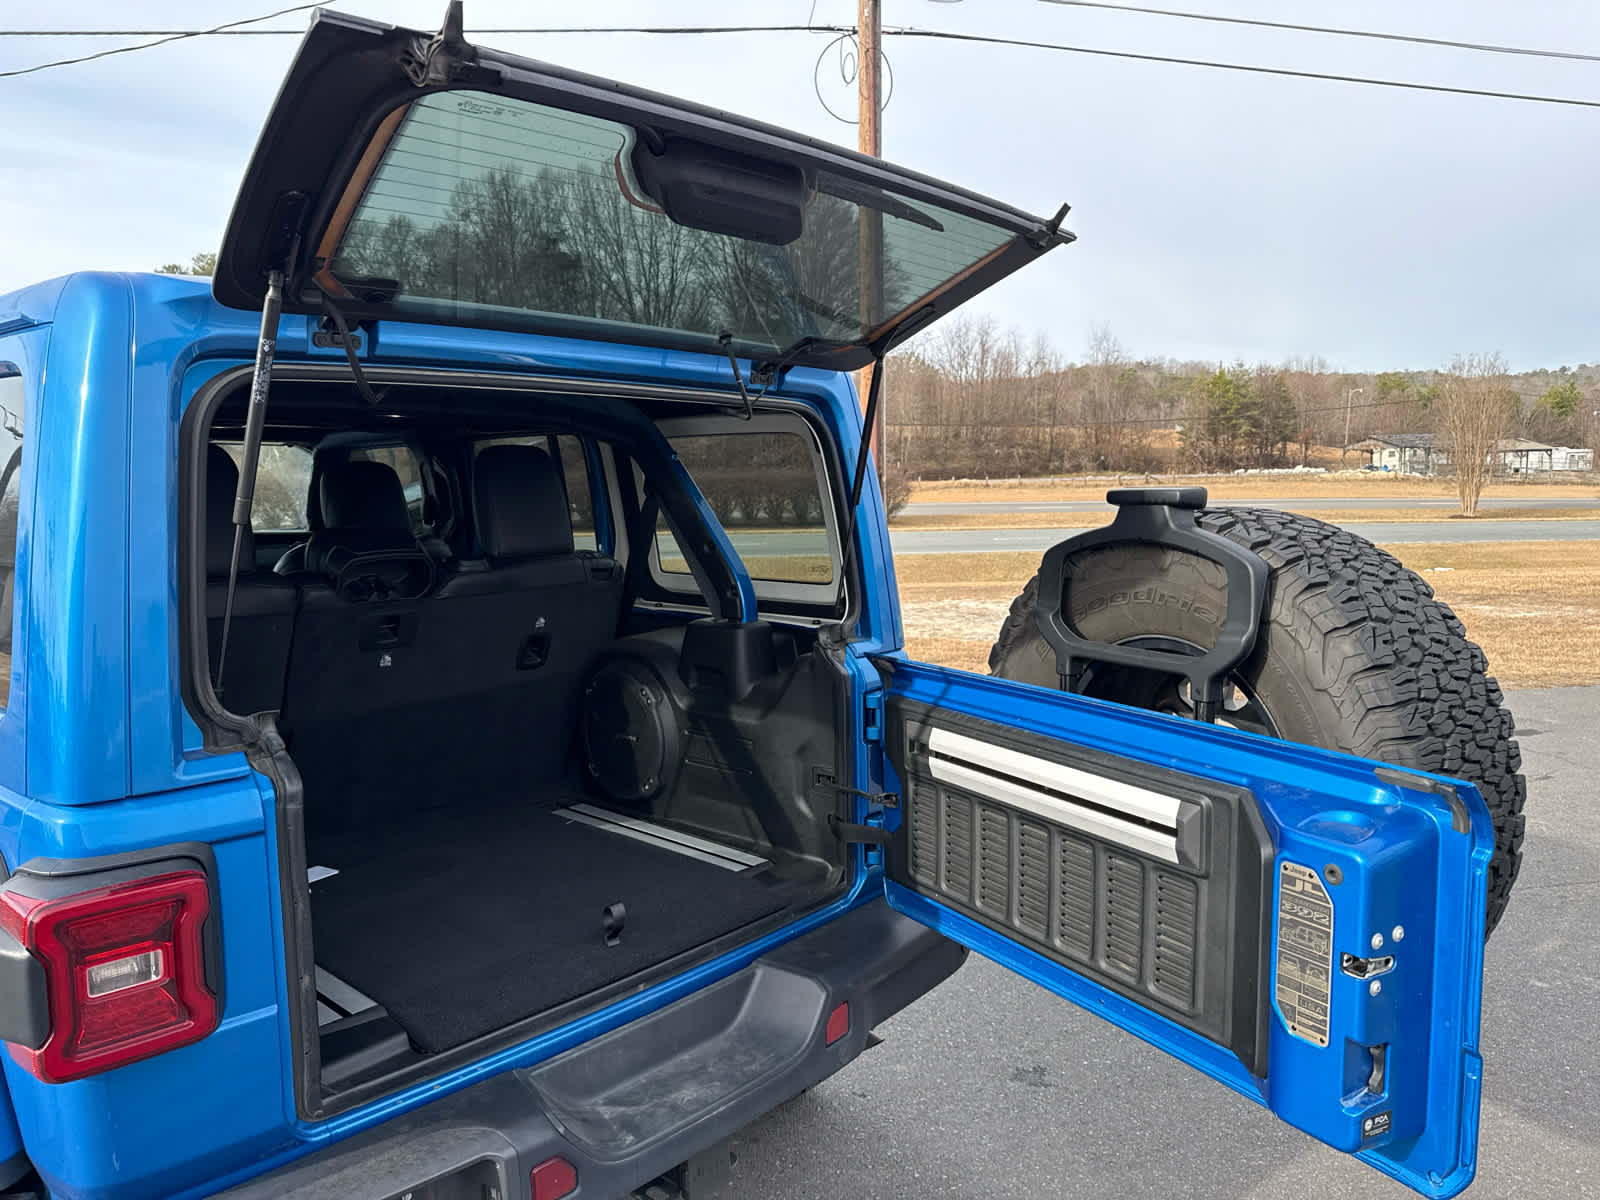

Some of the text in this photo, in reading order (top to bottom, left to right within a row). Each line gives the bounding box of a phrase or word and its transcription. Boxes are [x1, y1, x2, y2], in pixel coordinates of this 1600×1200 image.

[1289, 866, 1307, 878] Jeep
[1282, 879, 1324, 897] JL
[1282, 901, 1329, 925] 392
[1374, 1114, 1388, 1125] FCA
